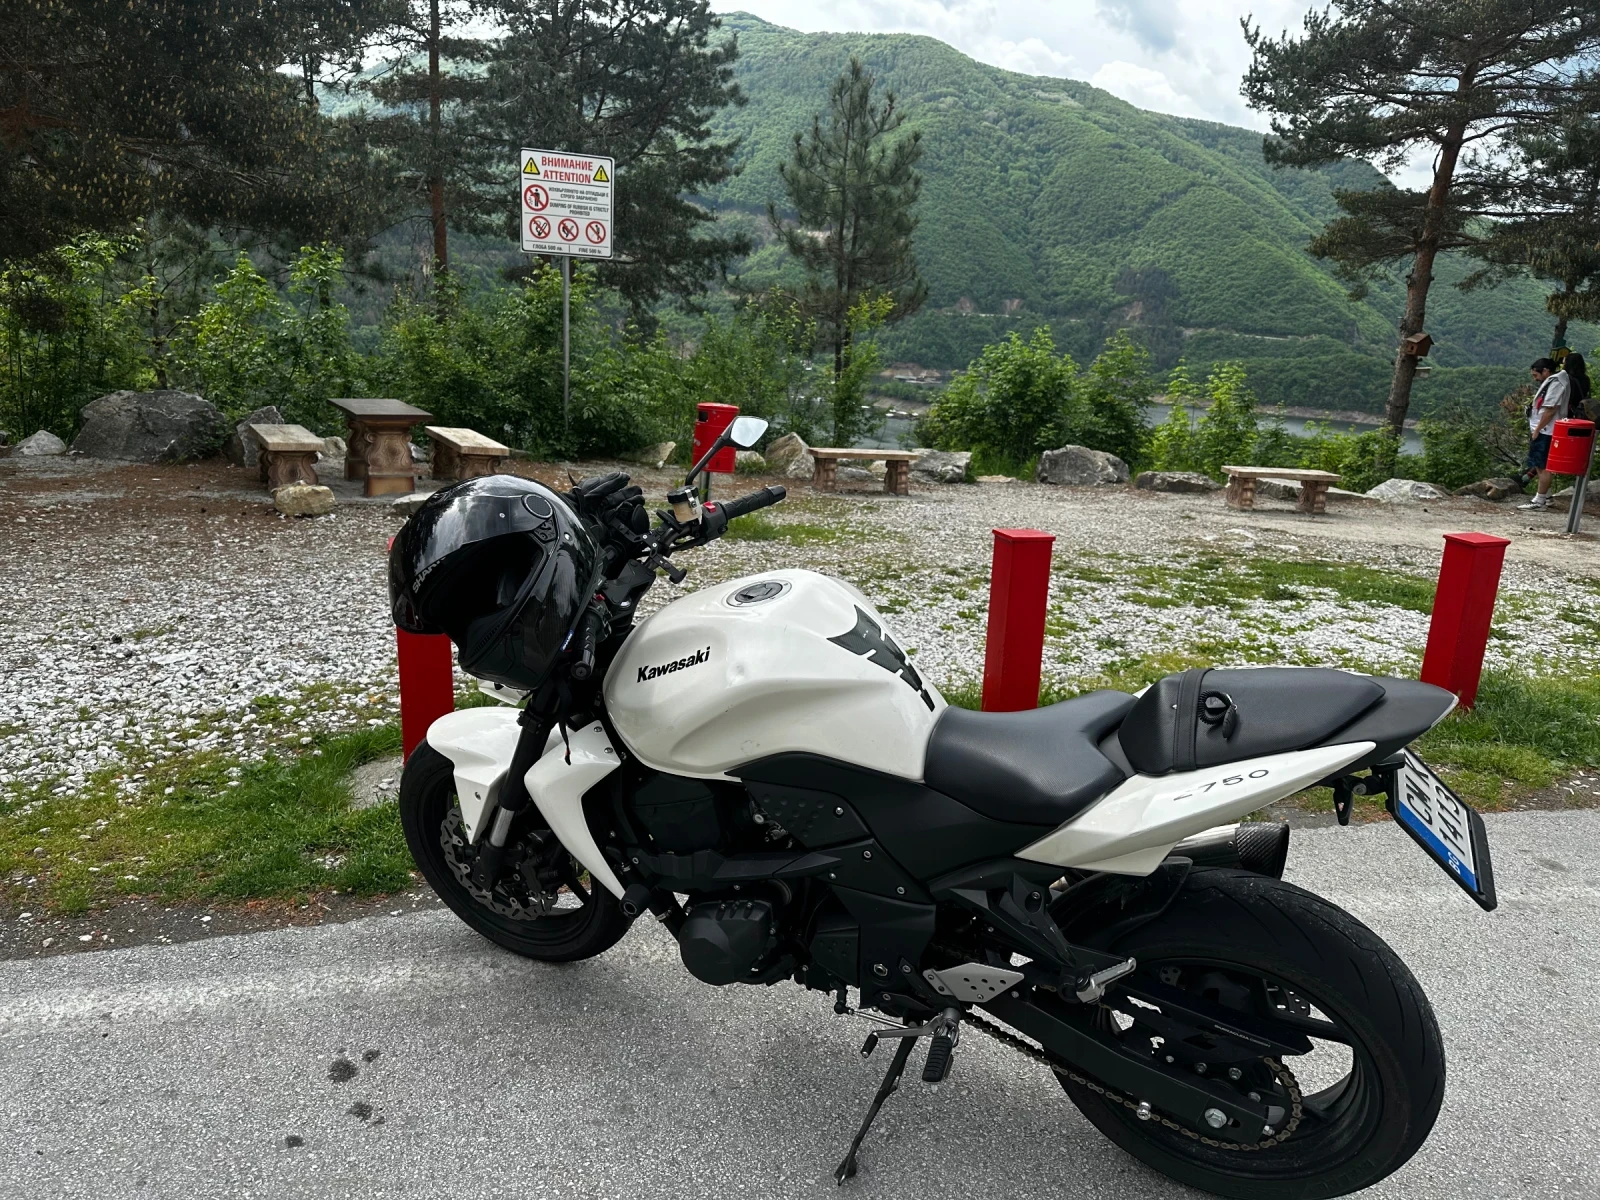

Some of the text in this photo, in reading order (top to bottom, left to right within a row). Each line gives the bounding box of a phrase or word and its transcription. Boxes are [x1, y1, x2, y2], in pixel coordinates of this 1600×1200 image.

[541, 156, 593, 171] ВНИМАНИЕ
[543, 170, 591, 183] ATTENTION
[412, 557, 446, 594] SHA
[637, 646, 710, 683] Kawasaki
[1435, 786, 1466, 856] 1413
[1448, 852, 1461, 875] BG
